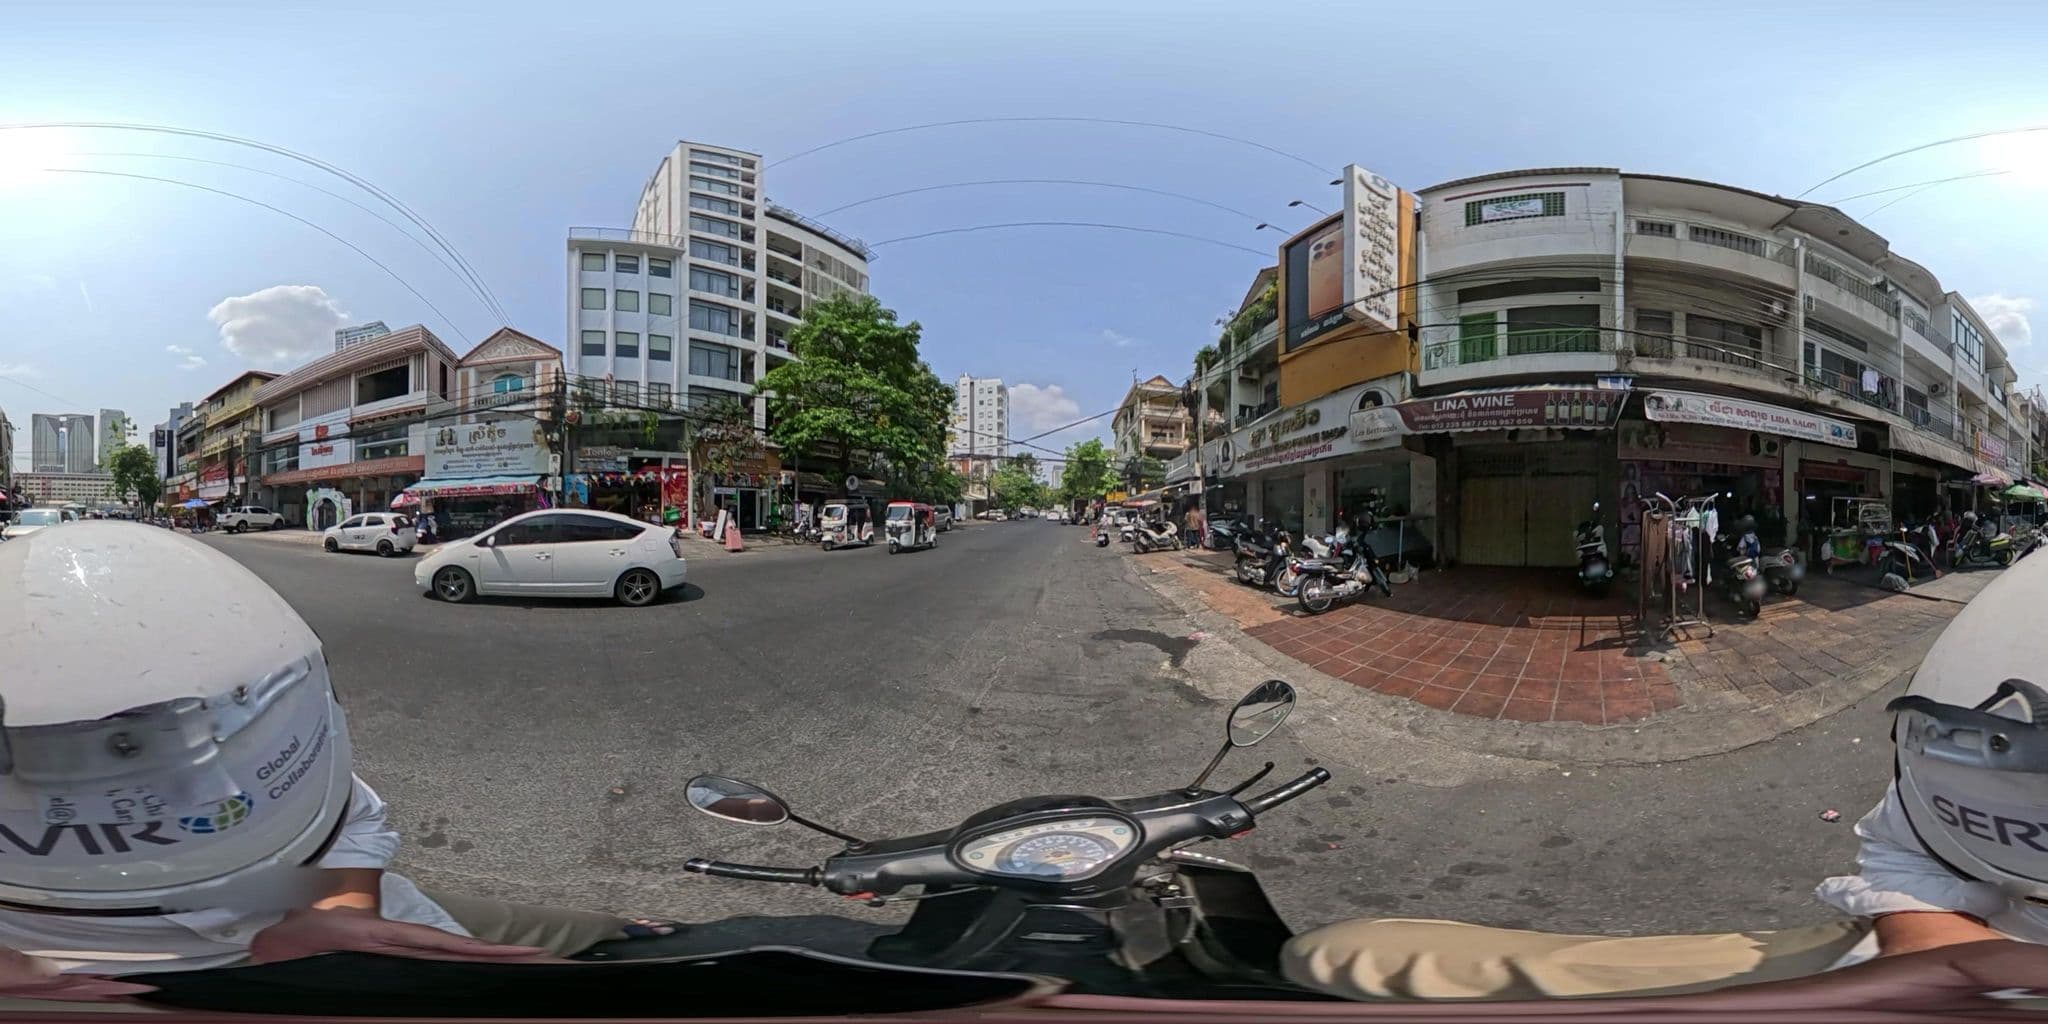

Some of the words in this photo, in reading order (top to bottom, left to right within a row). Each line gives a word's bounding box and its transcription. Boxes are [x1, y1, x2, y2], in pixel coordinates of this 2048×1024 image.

[1433, 398, 1468, 412] LINA
[1471, 394, 1515, 408] WINE
[1770, 413, 1791, 425] LIDA
[256, 735, 301, 780] Global
[1932, 794, 2048, 853] SER
